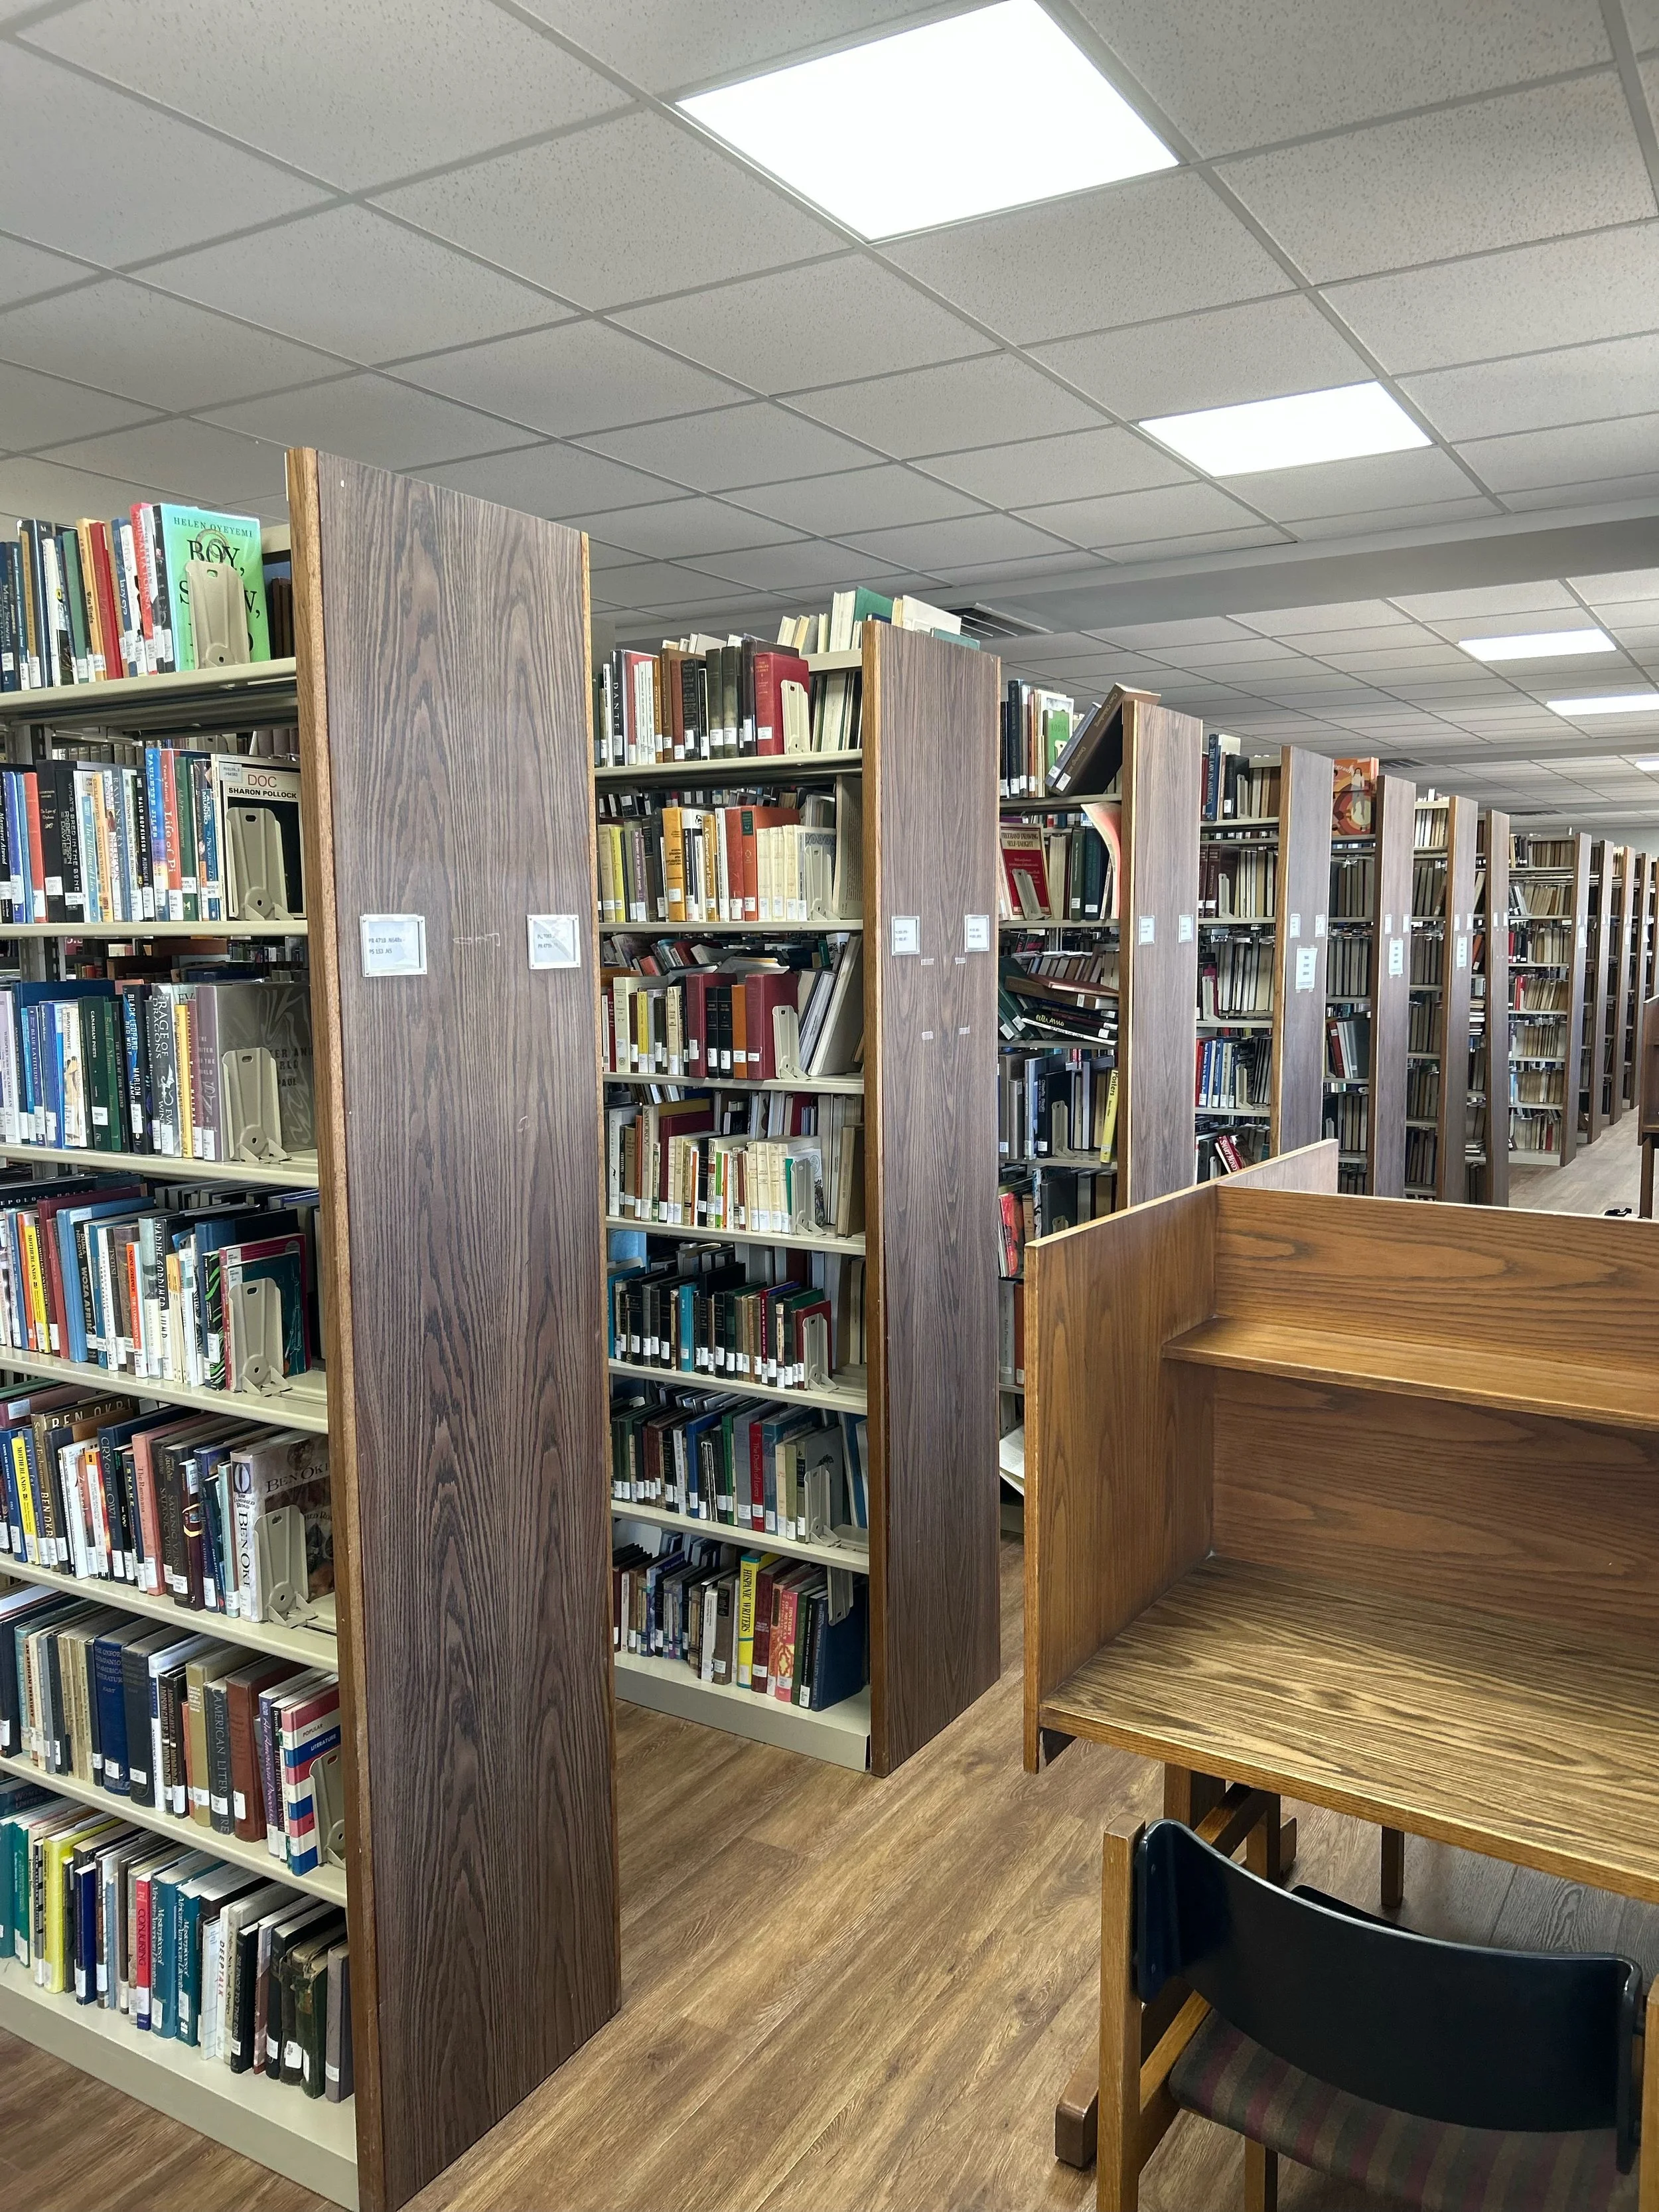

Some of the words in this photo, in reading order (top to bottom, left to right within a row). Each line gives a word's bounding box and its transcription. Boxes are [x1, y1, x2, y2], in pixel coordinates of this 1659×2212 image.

[173, 517, 206, 528] HELEN
[210, 524, 253, 538] OYEYEMI
[186, 539, 246, 577] BOY,
[148, 753, 157, 806] PAULETTE
[247, 774, 277, 788] DOC
[228, 787, 261, 796] SHARON
[262, 790, 297, 799] POLLOCK
[164, 811, 174, 838] Life
[72, 838, 77, 847] IN
[115, 826, 124, 848] CRY
[166, 841, 175, 854] of
[168, 859, 176, 873] Pi
[152, 997, 162, 1059] DRAGONS
[158, 1001, 170, 1039] RAGE
[161, 1043, 169, 1057] OF
[133, 1067, 141, 1096] MARLON
[1110, 1072, 1118, 1096] Posters
[28, 1234, 37, 1280] MOTHERLANDS
[100, 1437, 111, 1462] CRY
[17, 1446, 27, 1492] MOTHERLANDS
[36, 1449, 45, 1489] Enchantment
[104, 1463, 111, 1474] OF
[41, 1492, 50, 1512] BEN
[106, 1493, 117, 1522] OWL
[44, 1516, 53, 1538] OKR
[238, 1512, 249, 1550] BEN
[743, 1569, 752, 1600] HISPANIC
[742, 1602, 751, 1633] WRITERS
[25, 1644, 30, 1655] AN
[302, 1724, 324, 1737] POPULAR
[310, 1733, 337, 1752] LITERATURE
[265, 1783, 275, 1825] Processio
[234, 1991, 240, 2002] TO
